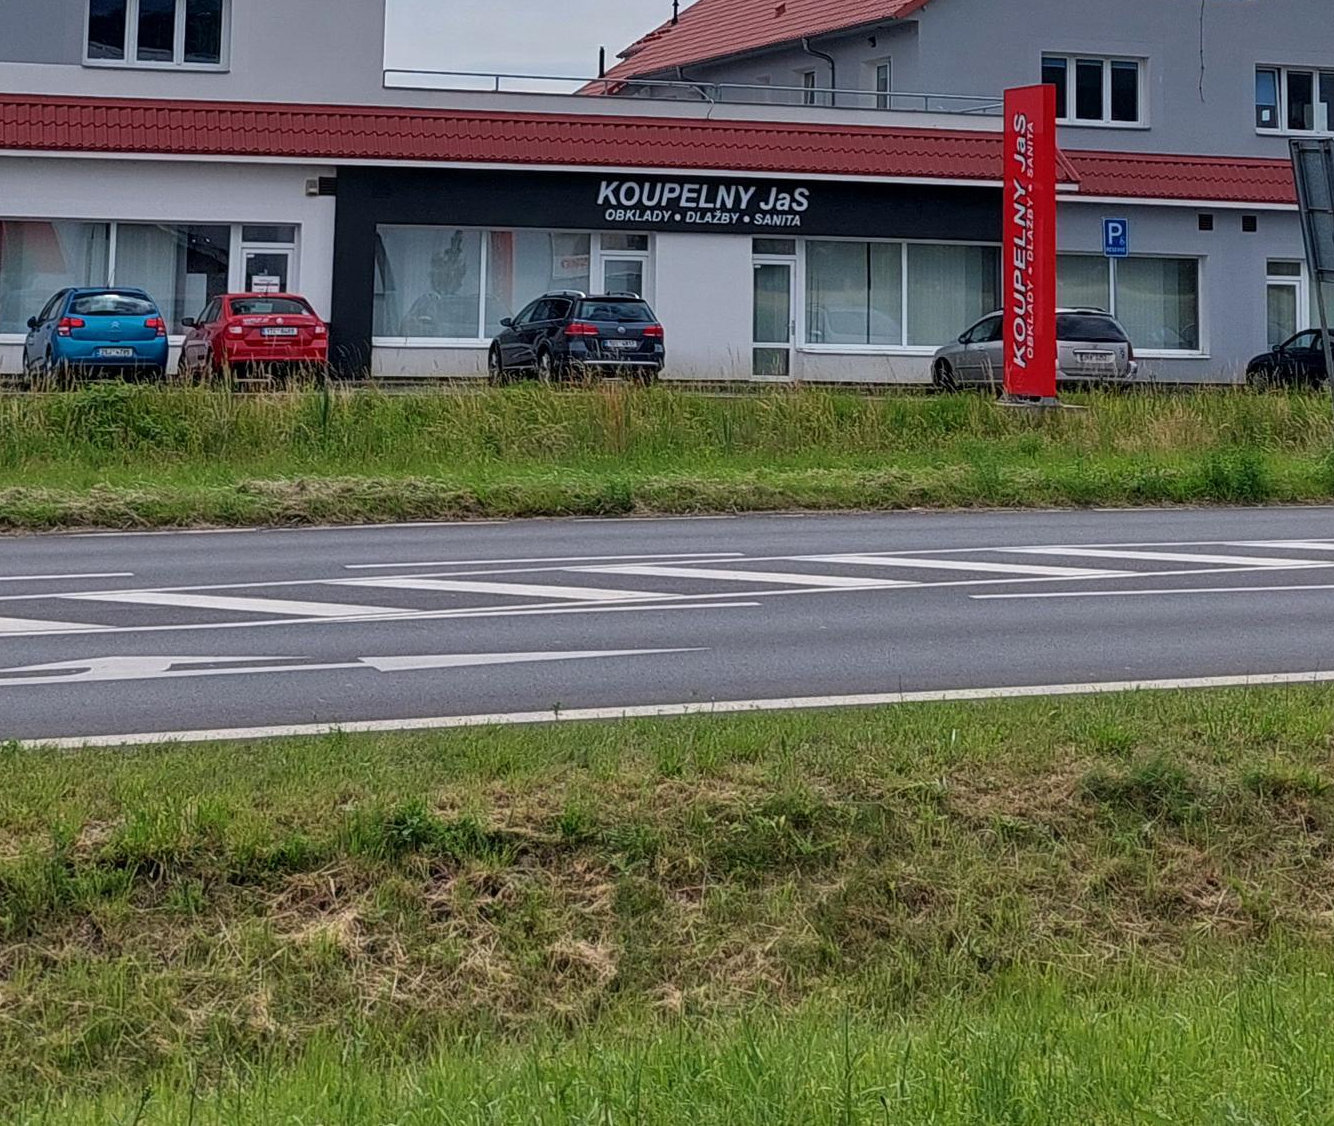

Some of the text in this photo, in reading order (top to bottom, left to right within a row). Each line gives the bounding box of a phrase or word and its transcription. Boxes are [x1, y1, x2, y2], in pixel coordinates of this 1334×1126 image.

[597, 181, 810, 212] KOUPELNY JaS
[605, 208, 801, 227] OBKLADY DLAŽBY SANITA
[1013, 114, 1026, 368] KOUPELNY JaS
[1108, 222, 1123, 245] P
[1026, 279, 1034, 359] OBKLADY
